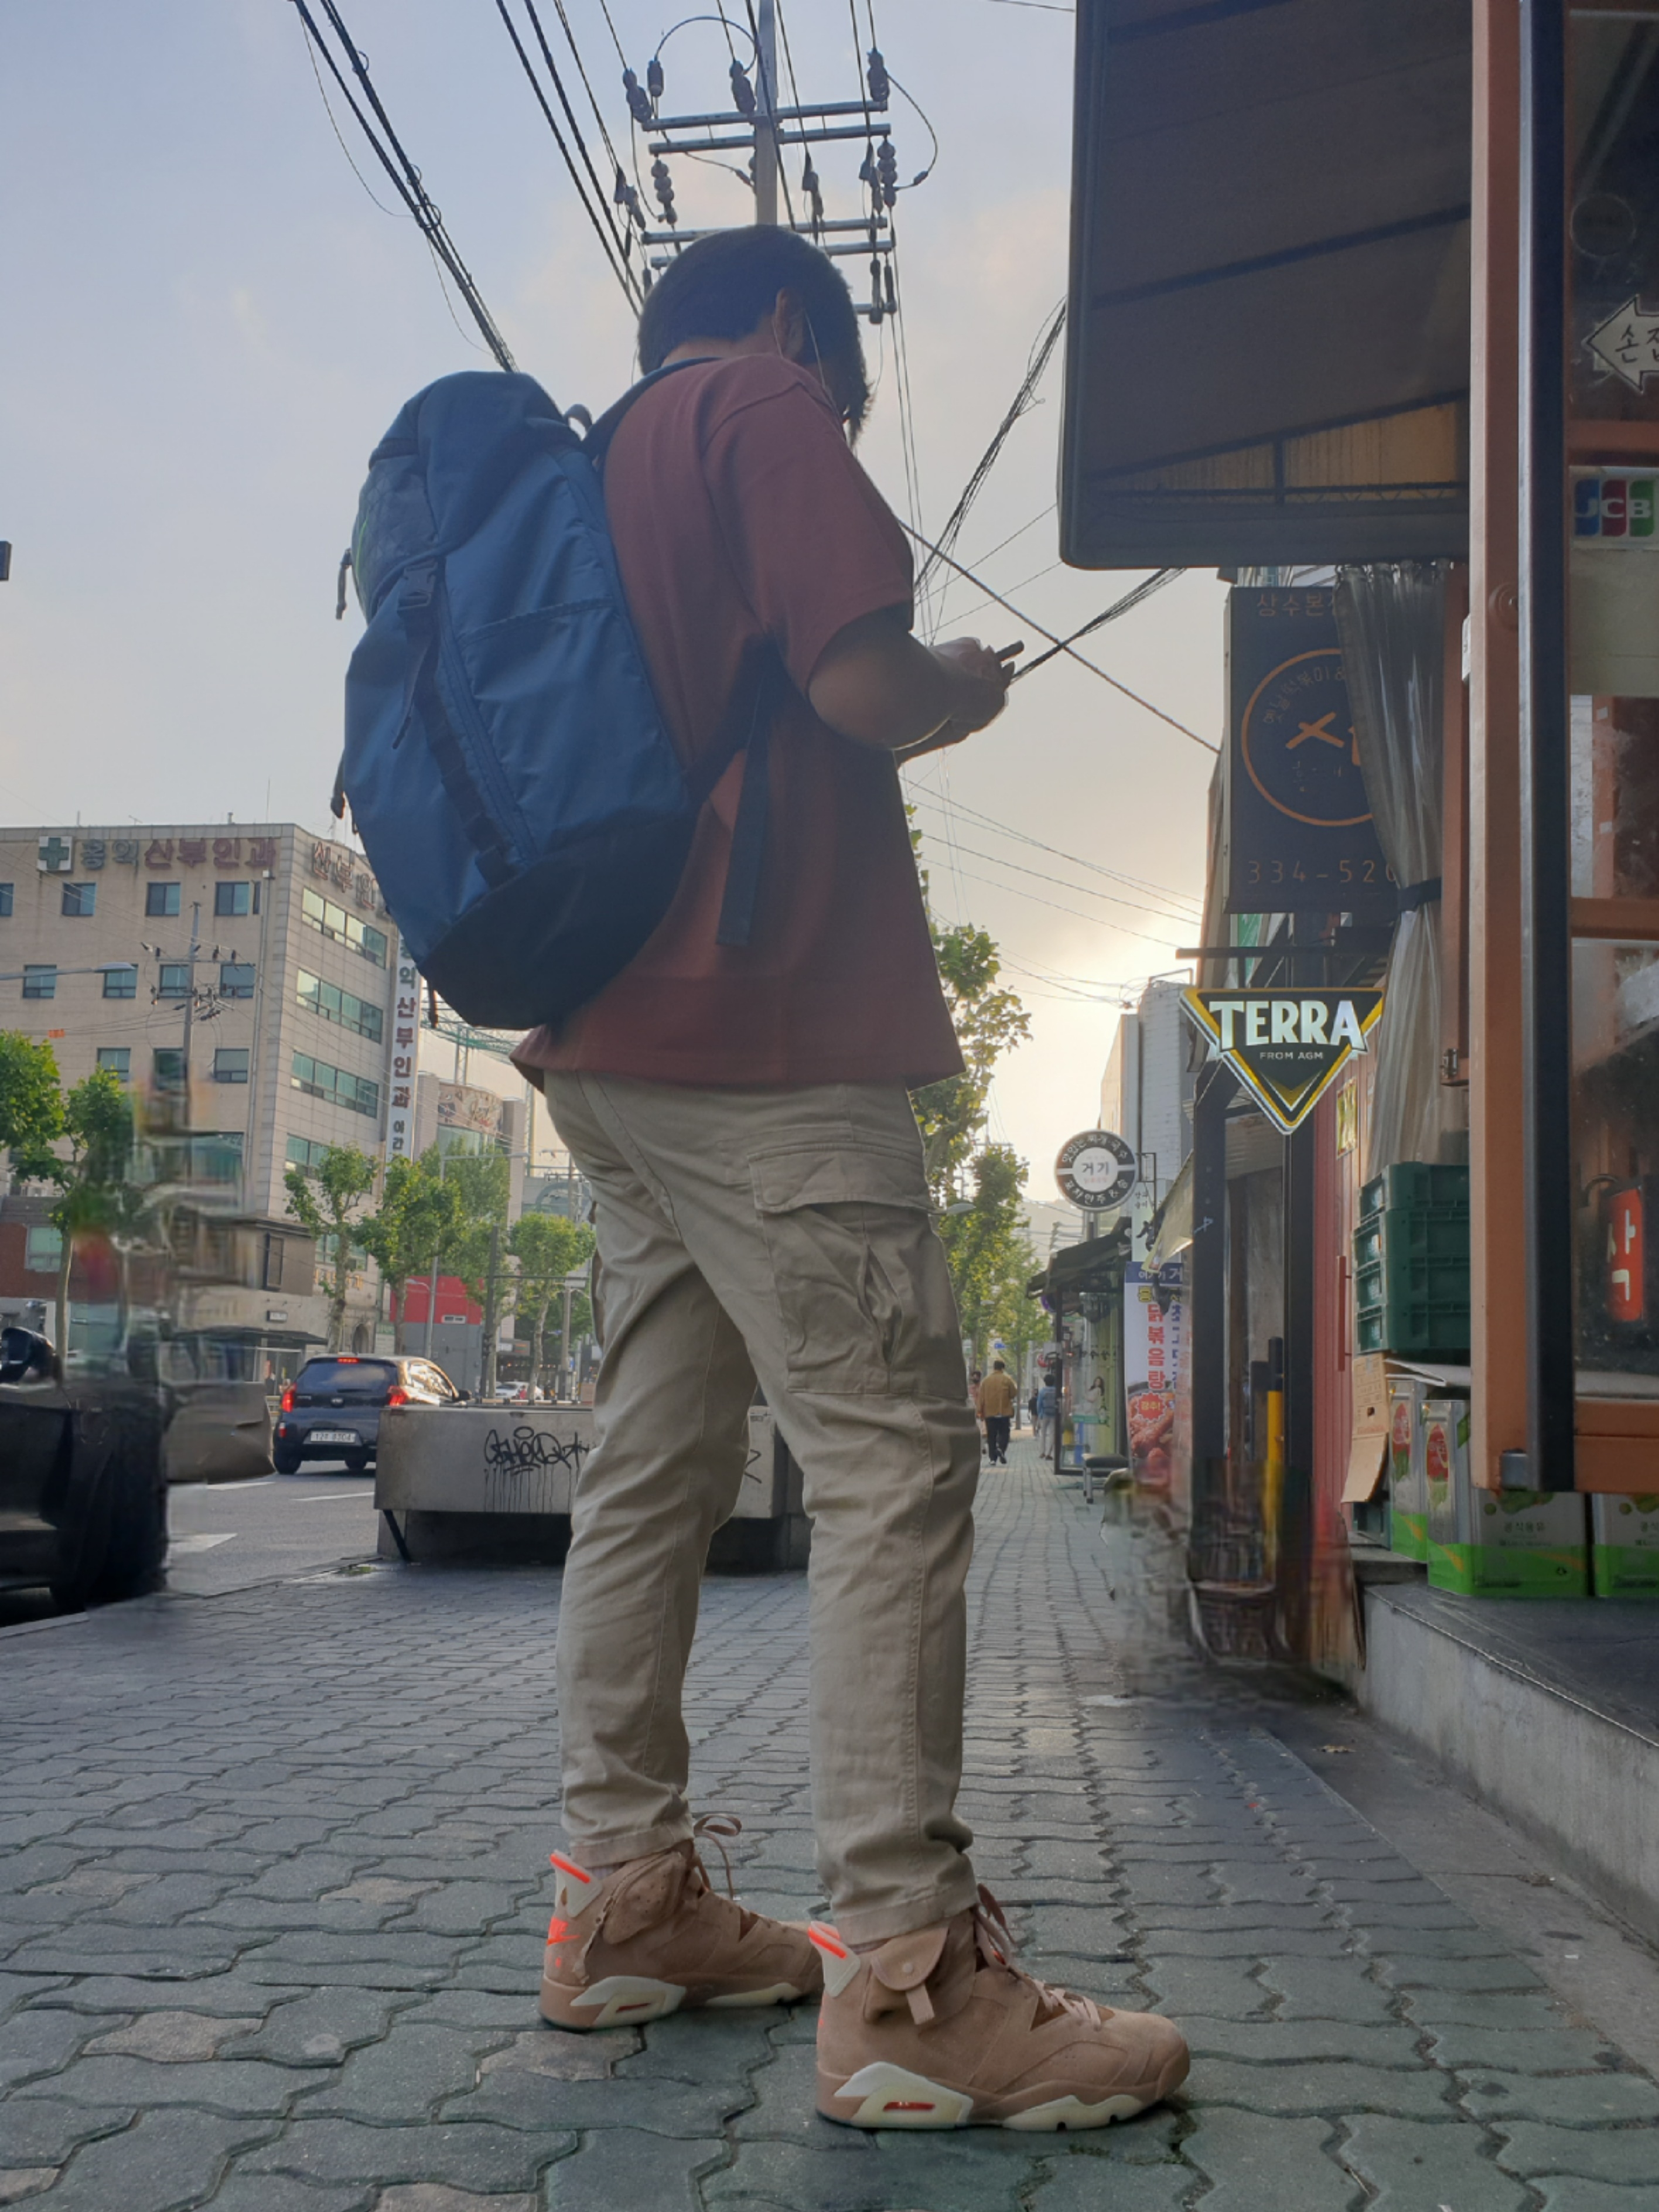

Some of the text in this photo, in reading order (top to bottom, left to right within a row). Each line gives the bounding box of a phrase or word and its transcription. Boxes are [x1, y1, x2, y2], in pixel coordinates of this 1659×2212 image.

[1576, 498, 1651, 518] JCB
[1257, 593, 1333, 616] 상수본
[1209, 999, 1367, 1050] TERRA
[1259, 1052, 1324, 1060] FROM AGM
[1081, 1161, 1110, 1176] 거기
